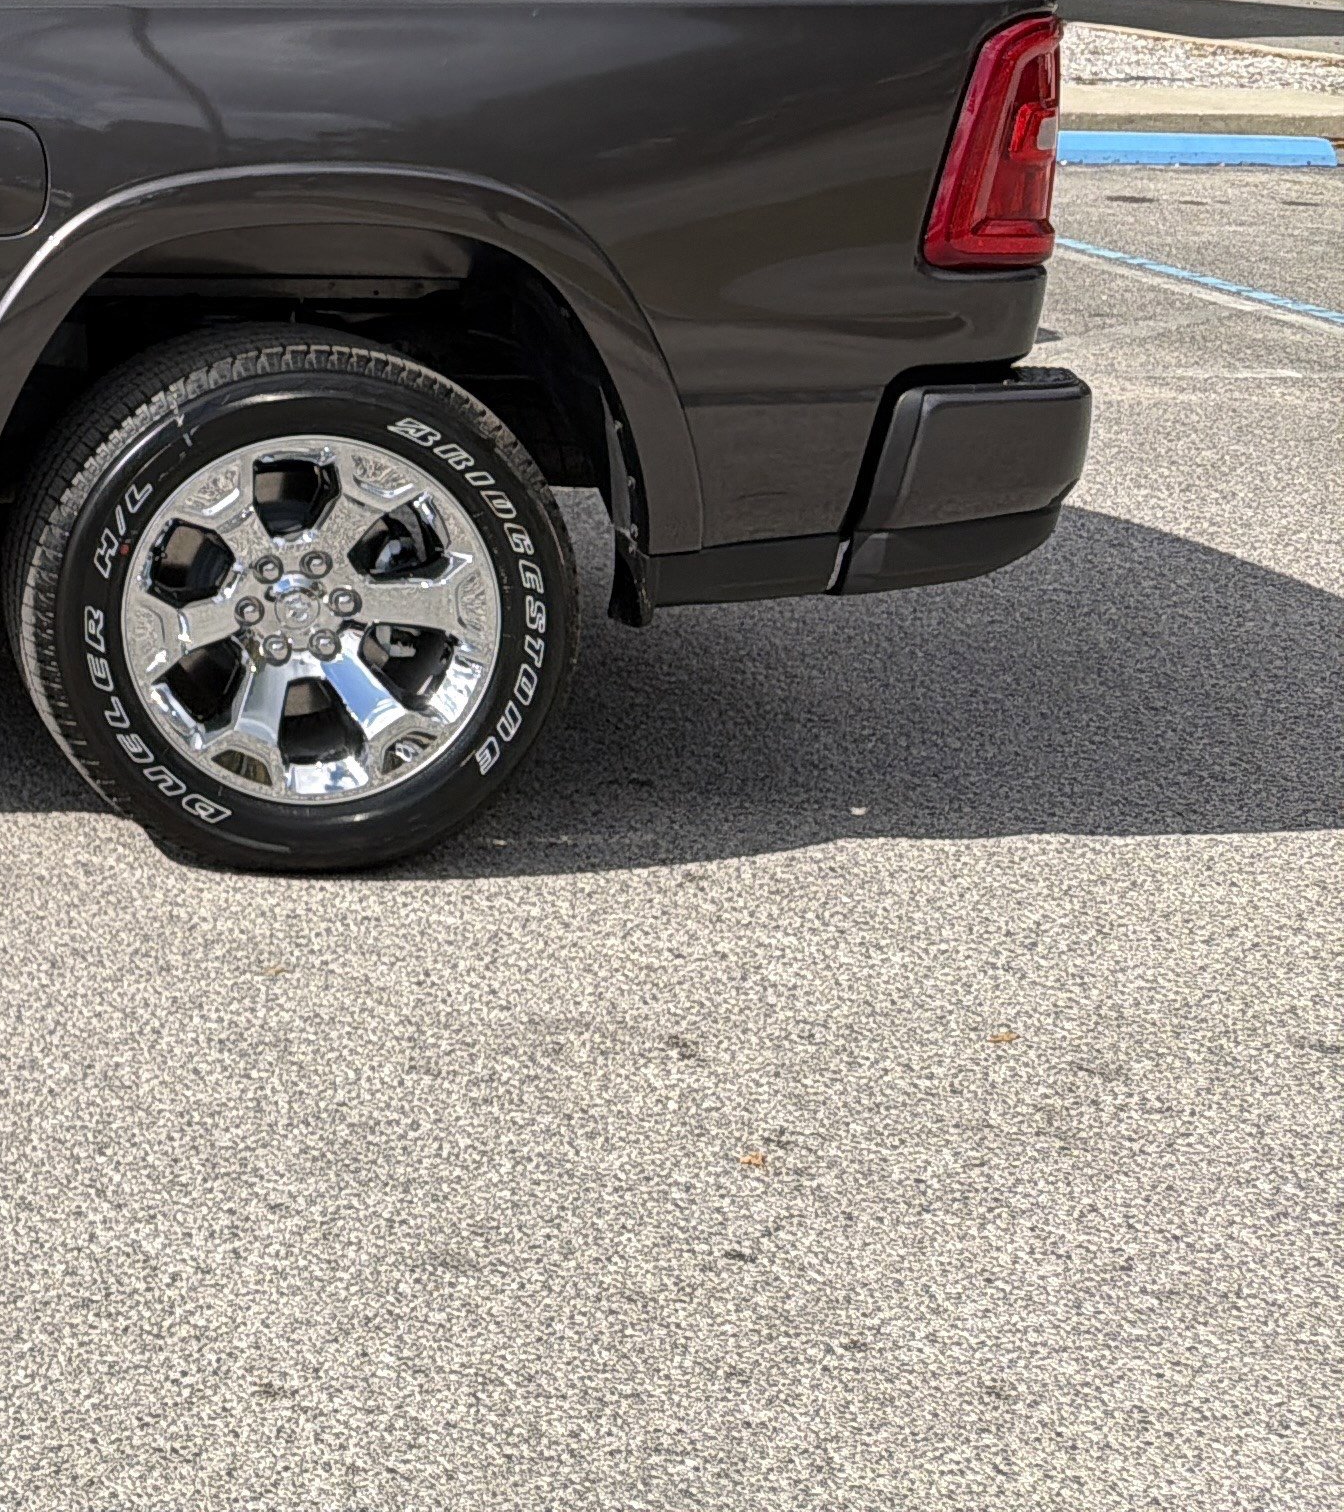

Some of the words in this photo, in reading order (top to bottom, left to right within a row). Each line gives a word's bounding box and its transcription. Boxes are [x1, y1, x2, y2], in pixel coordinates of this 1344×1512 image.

[93, 483, 153, 579] H/L
[387, 416, 547, 776] BRIDGESTONE
[84, 605, 233, 824] DUELER
